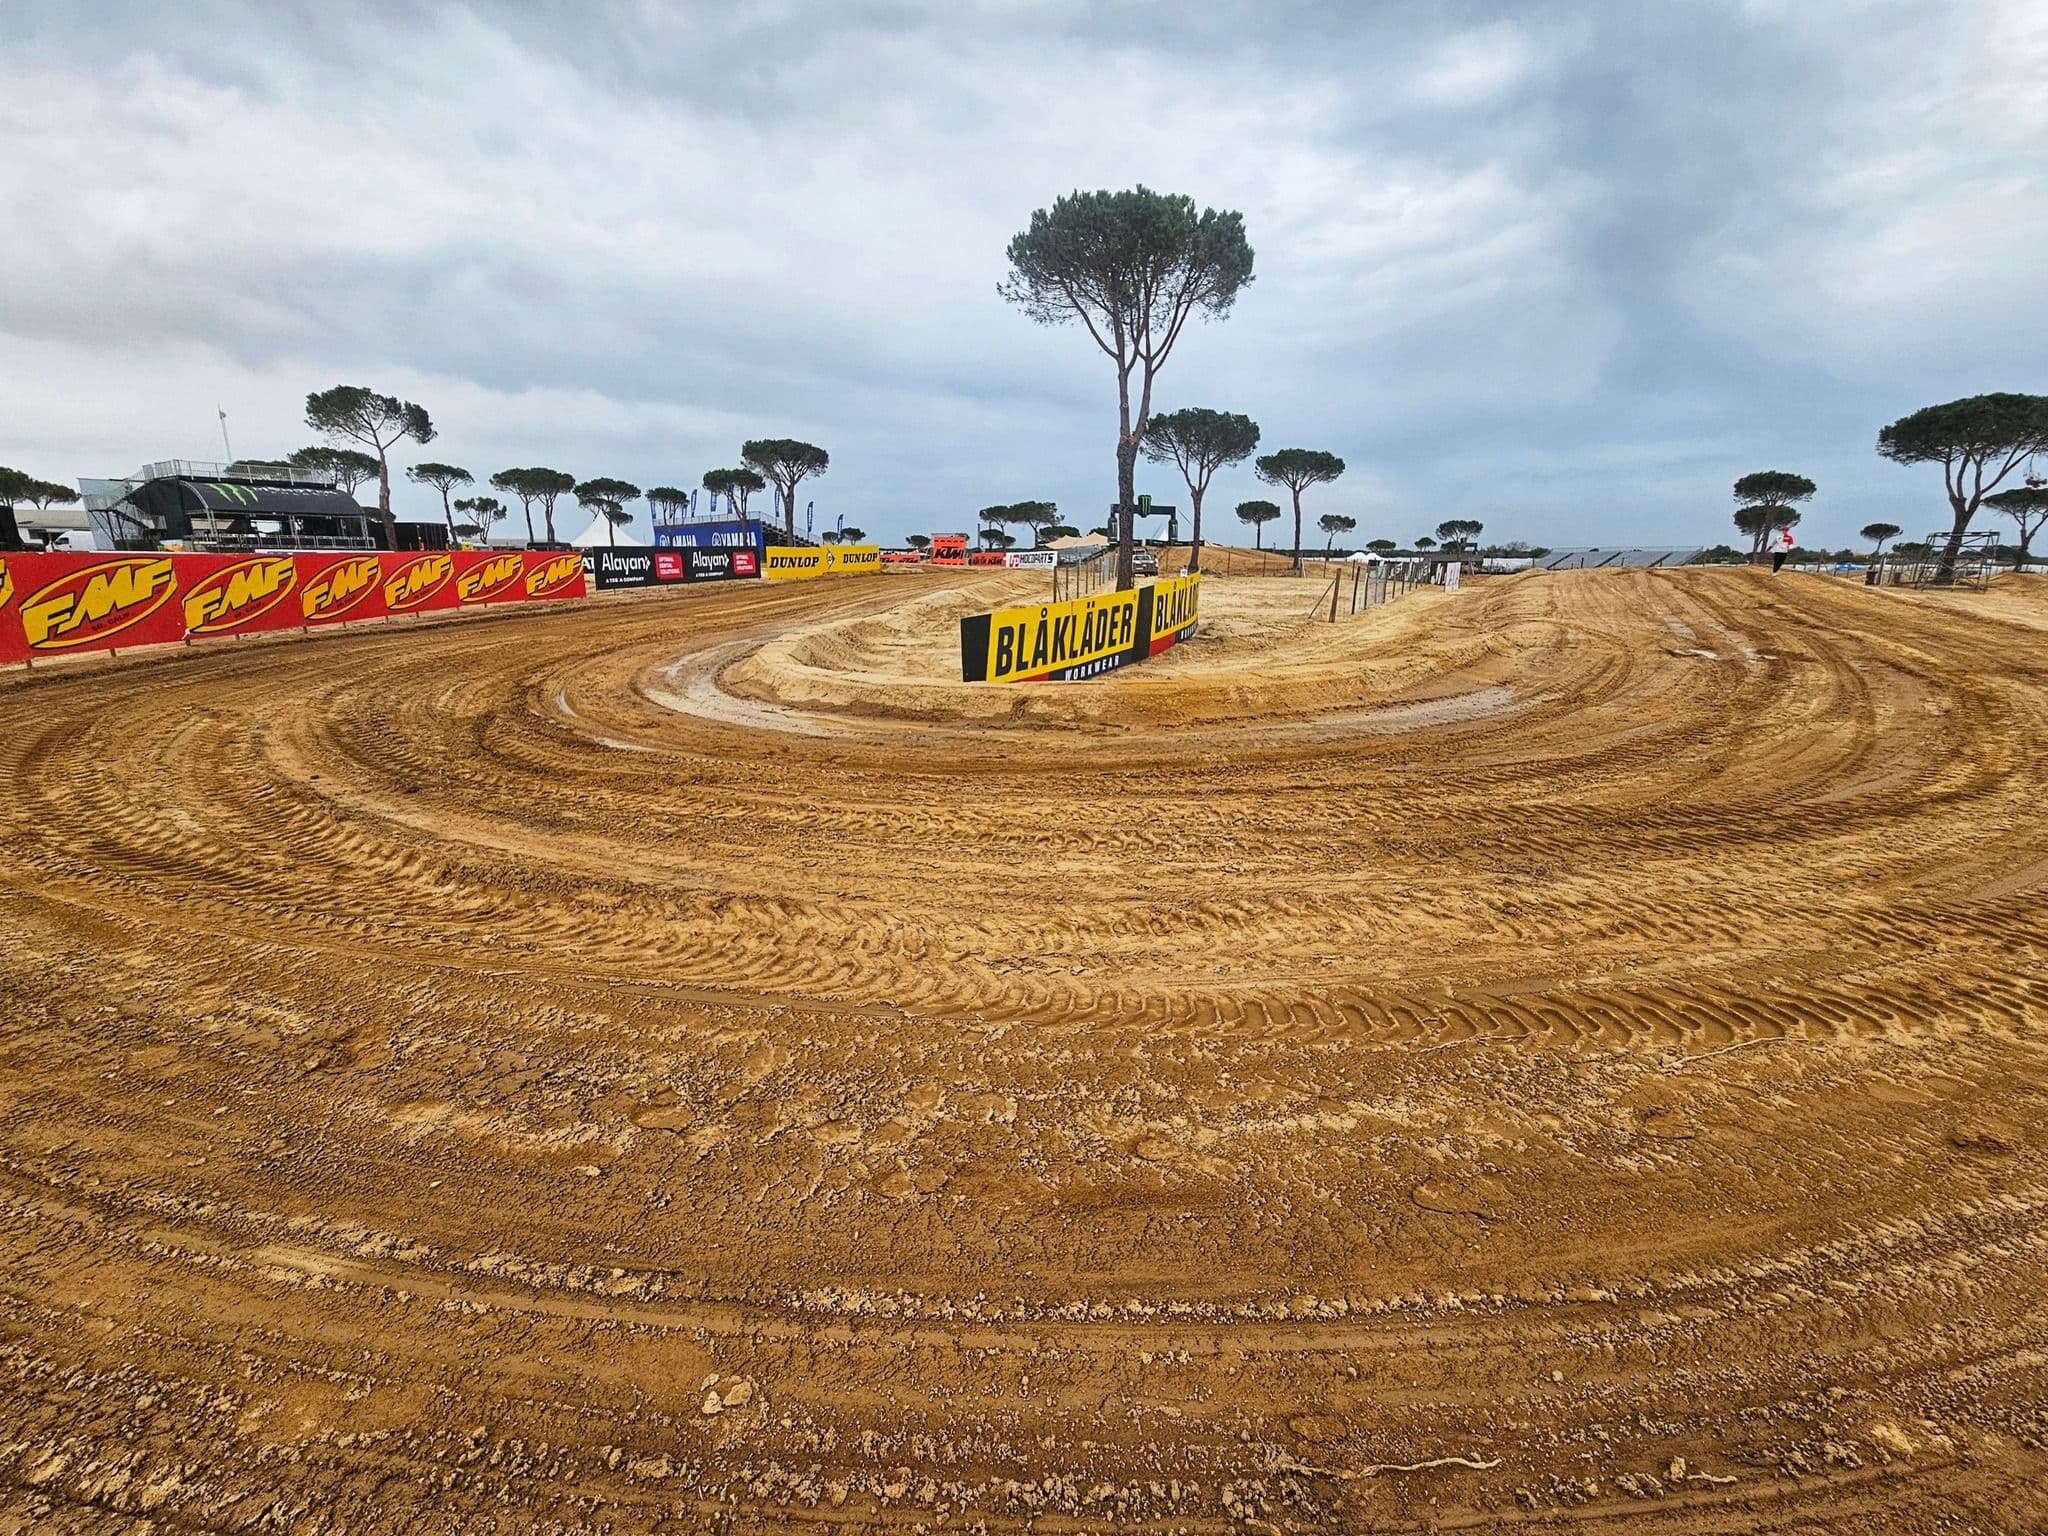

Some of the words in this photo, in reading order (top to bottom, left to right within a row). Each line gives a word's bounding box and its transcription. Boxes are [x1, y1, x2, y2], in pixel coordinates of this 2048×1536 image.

[602, 552, 646, 576] Alayan
[692, 550, 725, 571] Alayan
[769, 556, 820, 569] DUNLOP
[843, 552, 878, 564] DUNLOP
[934, 546, 964, 559] KTM
[184, 556, 294, 630] FMF
[303, 556, 379, 617] FMF
[385, 552, 451, 608] FMF
[458, 553, 523, 601] FMF
[526, 554, 583, 596] FMF
[22, 557, 173, 646] FMF
[995, 601, 1133, 677] BLÅKLÄDER
[1065, 655, 1119, 681] WORKWEAR
